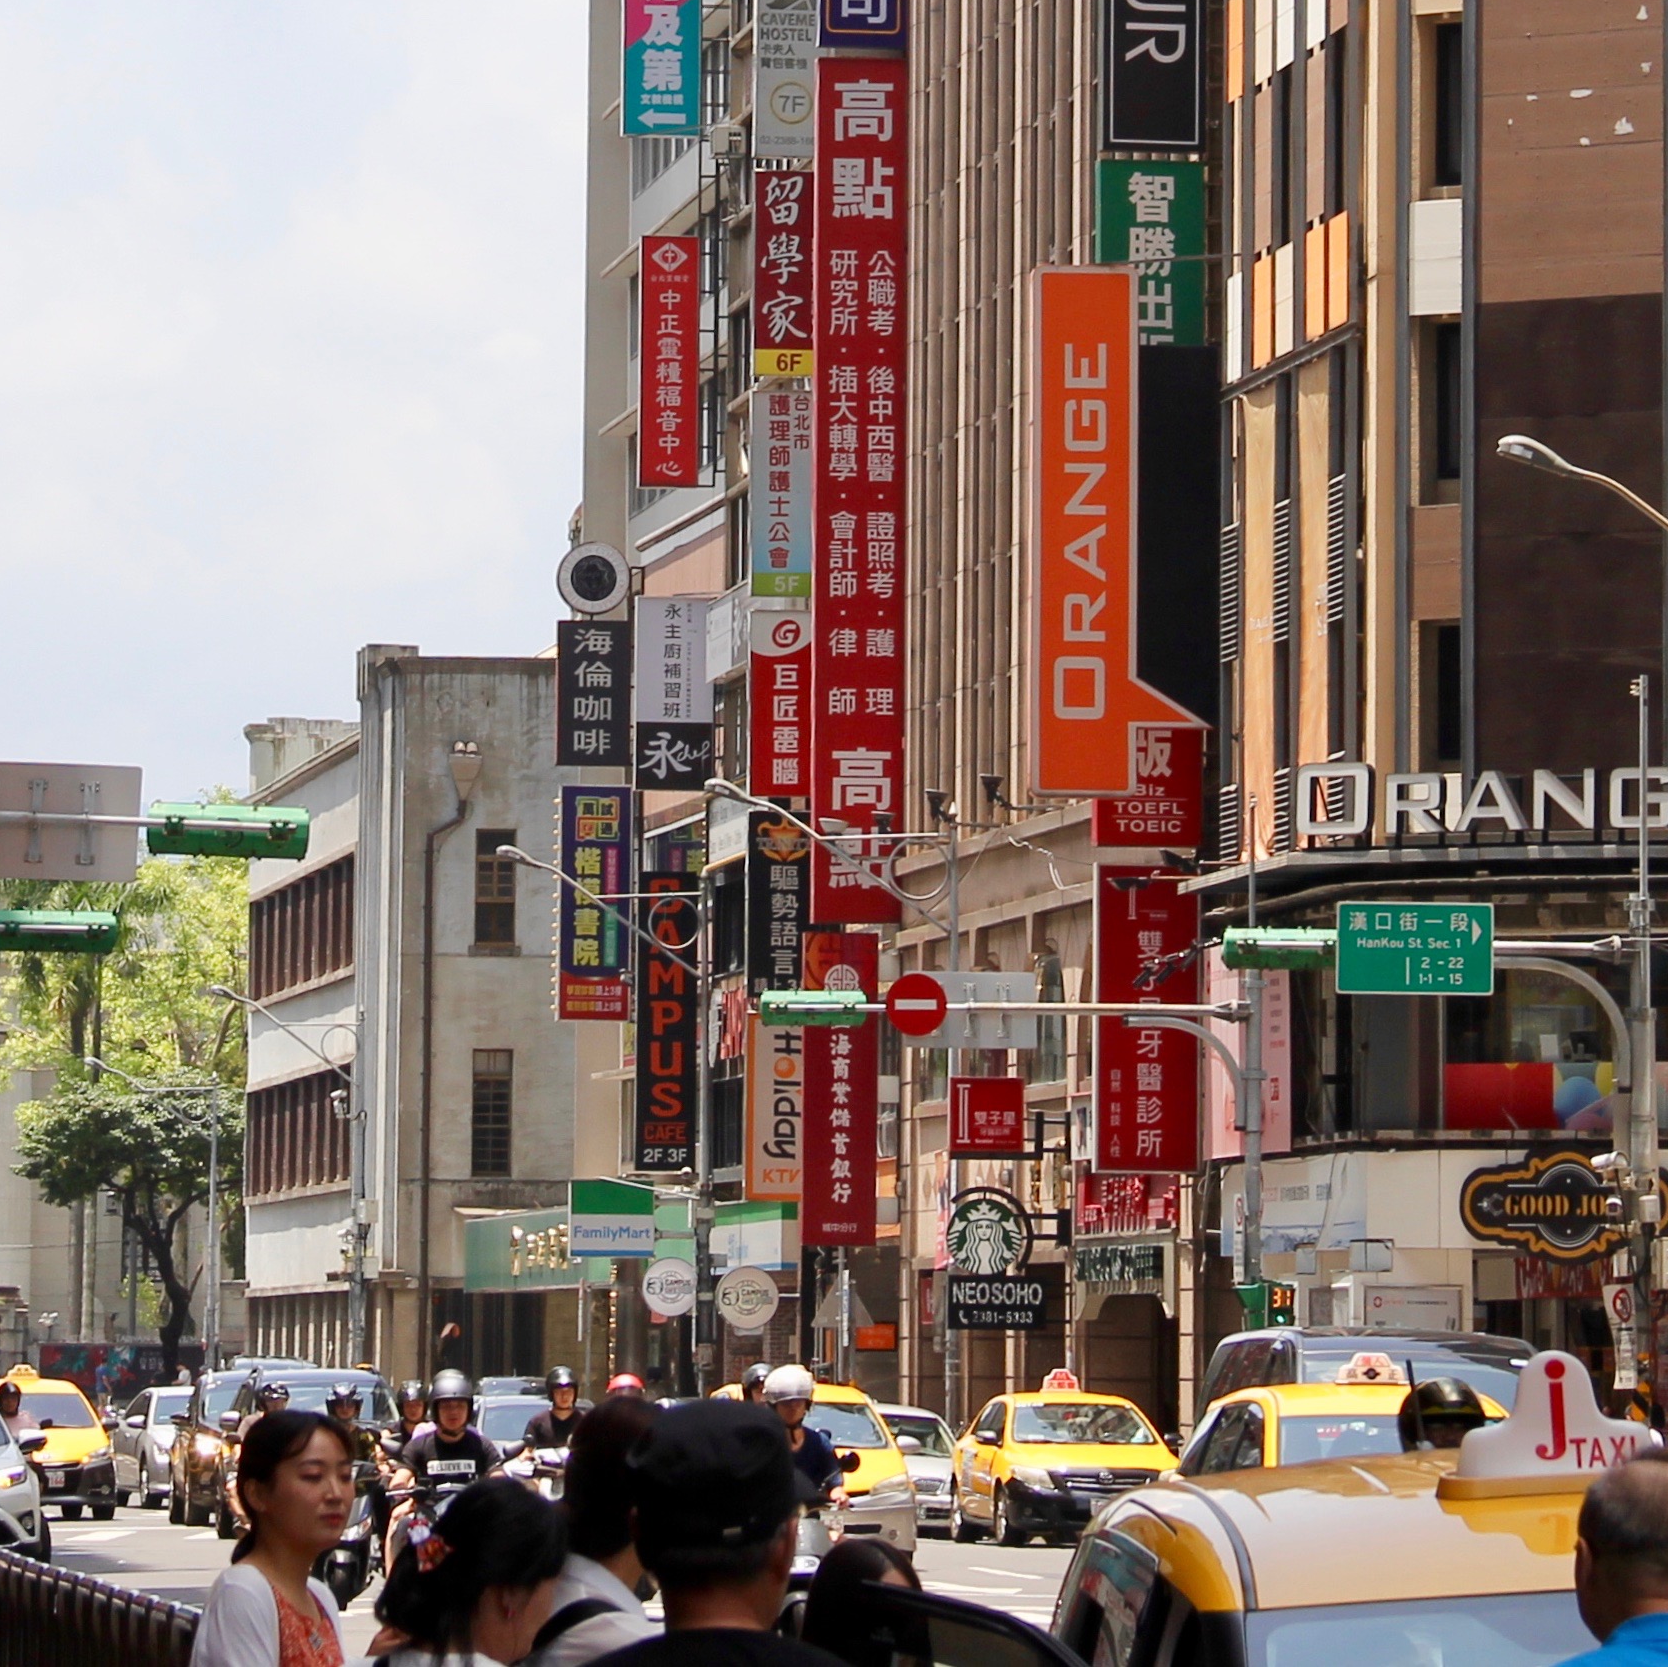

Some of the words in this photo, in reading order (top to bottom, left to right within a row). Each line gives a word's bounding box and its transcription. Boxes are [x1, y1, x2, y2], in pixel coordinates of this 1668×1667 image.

[760, 28, 813, 42] HOSTEL
[778, 95, 807, 114] 7F
[832, 78, 895, 221] 高點
[760, 175, 808, 345] 留學家
[829, 250, 858, 337] 研究所
[867, 250, 896, 337] 公職考
[654, 288, 684, 478] 中正靈糧福音中心
[776, 352, 803, 373] 6F
[793, 394, 810, 452] 台北市
[828, 364, 858, 481] 插大轉學
[866, 365, 896, 482] 後中西醫
[768, 395, 791, 569] 護理師護士公會
[828, 511, 858, 598] 會計師
[866, 511, 895, 599] 證照考
[1054, 343, 1107, 721] ORANGE
[774, 575, 799, 593] 5F
[573, 628, 613, 755] 海倫咖啡
[662, 603, 682, 719] 永主廚補習班
[827, 628, 858, 716] 律師
[865, 628, 895, 716] 護理
[772, 664, 799, 786] 巨匠電腦
[828, 746, 895, 890] 高點
[1113, 800, 1185, 817] TOEFL
[1116, 818, 1182, 834] TOEIC
[572, 847, 601, 967] 楷模書院
[769, 864, 800, 976] 驅勢語言
[1348, 911, 1470, 933] 漢口街一段
[1356, 937, 1405, 949] HanKou
[1407, 937, 1424, 949] St.
[1427, 937, 1452, 949] Sec.
[648, 878, 685, 1118] CAMPUS
[644, 1123, 687, 1144] CAFE
[829, 1021, 853, 1205] 海商業儲蓄銀行
[973, 1111, 1016, 1126] 雙子星
[762, 1168, 801, 1184] KTV
[1504, 1193, 1570, 1217] GOOD
[573, 1225, 651, 1242] FamilyMart
